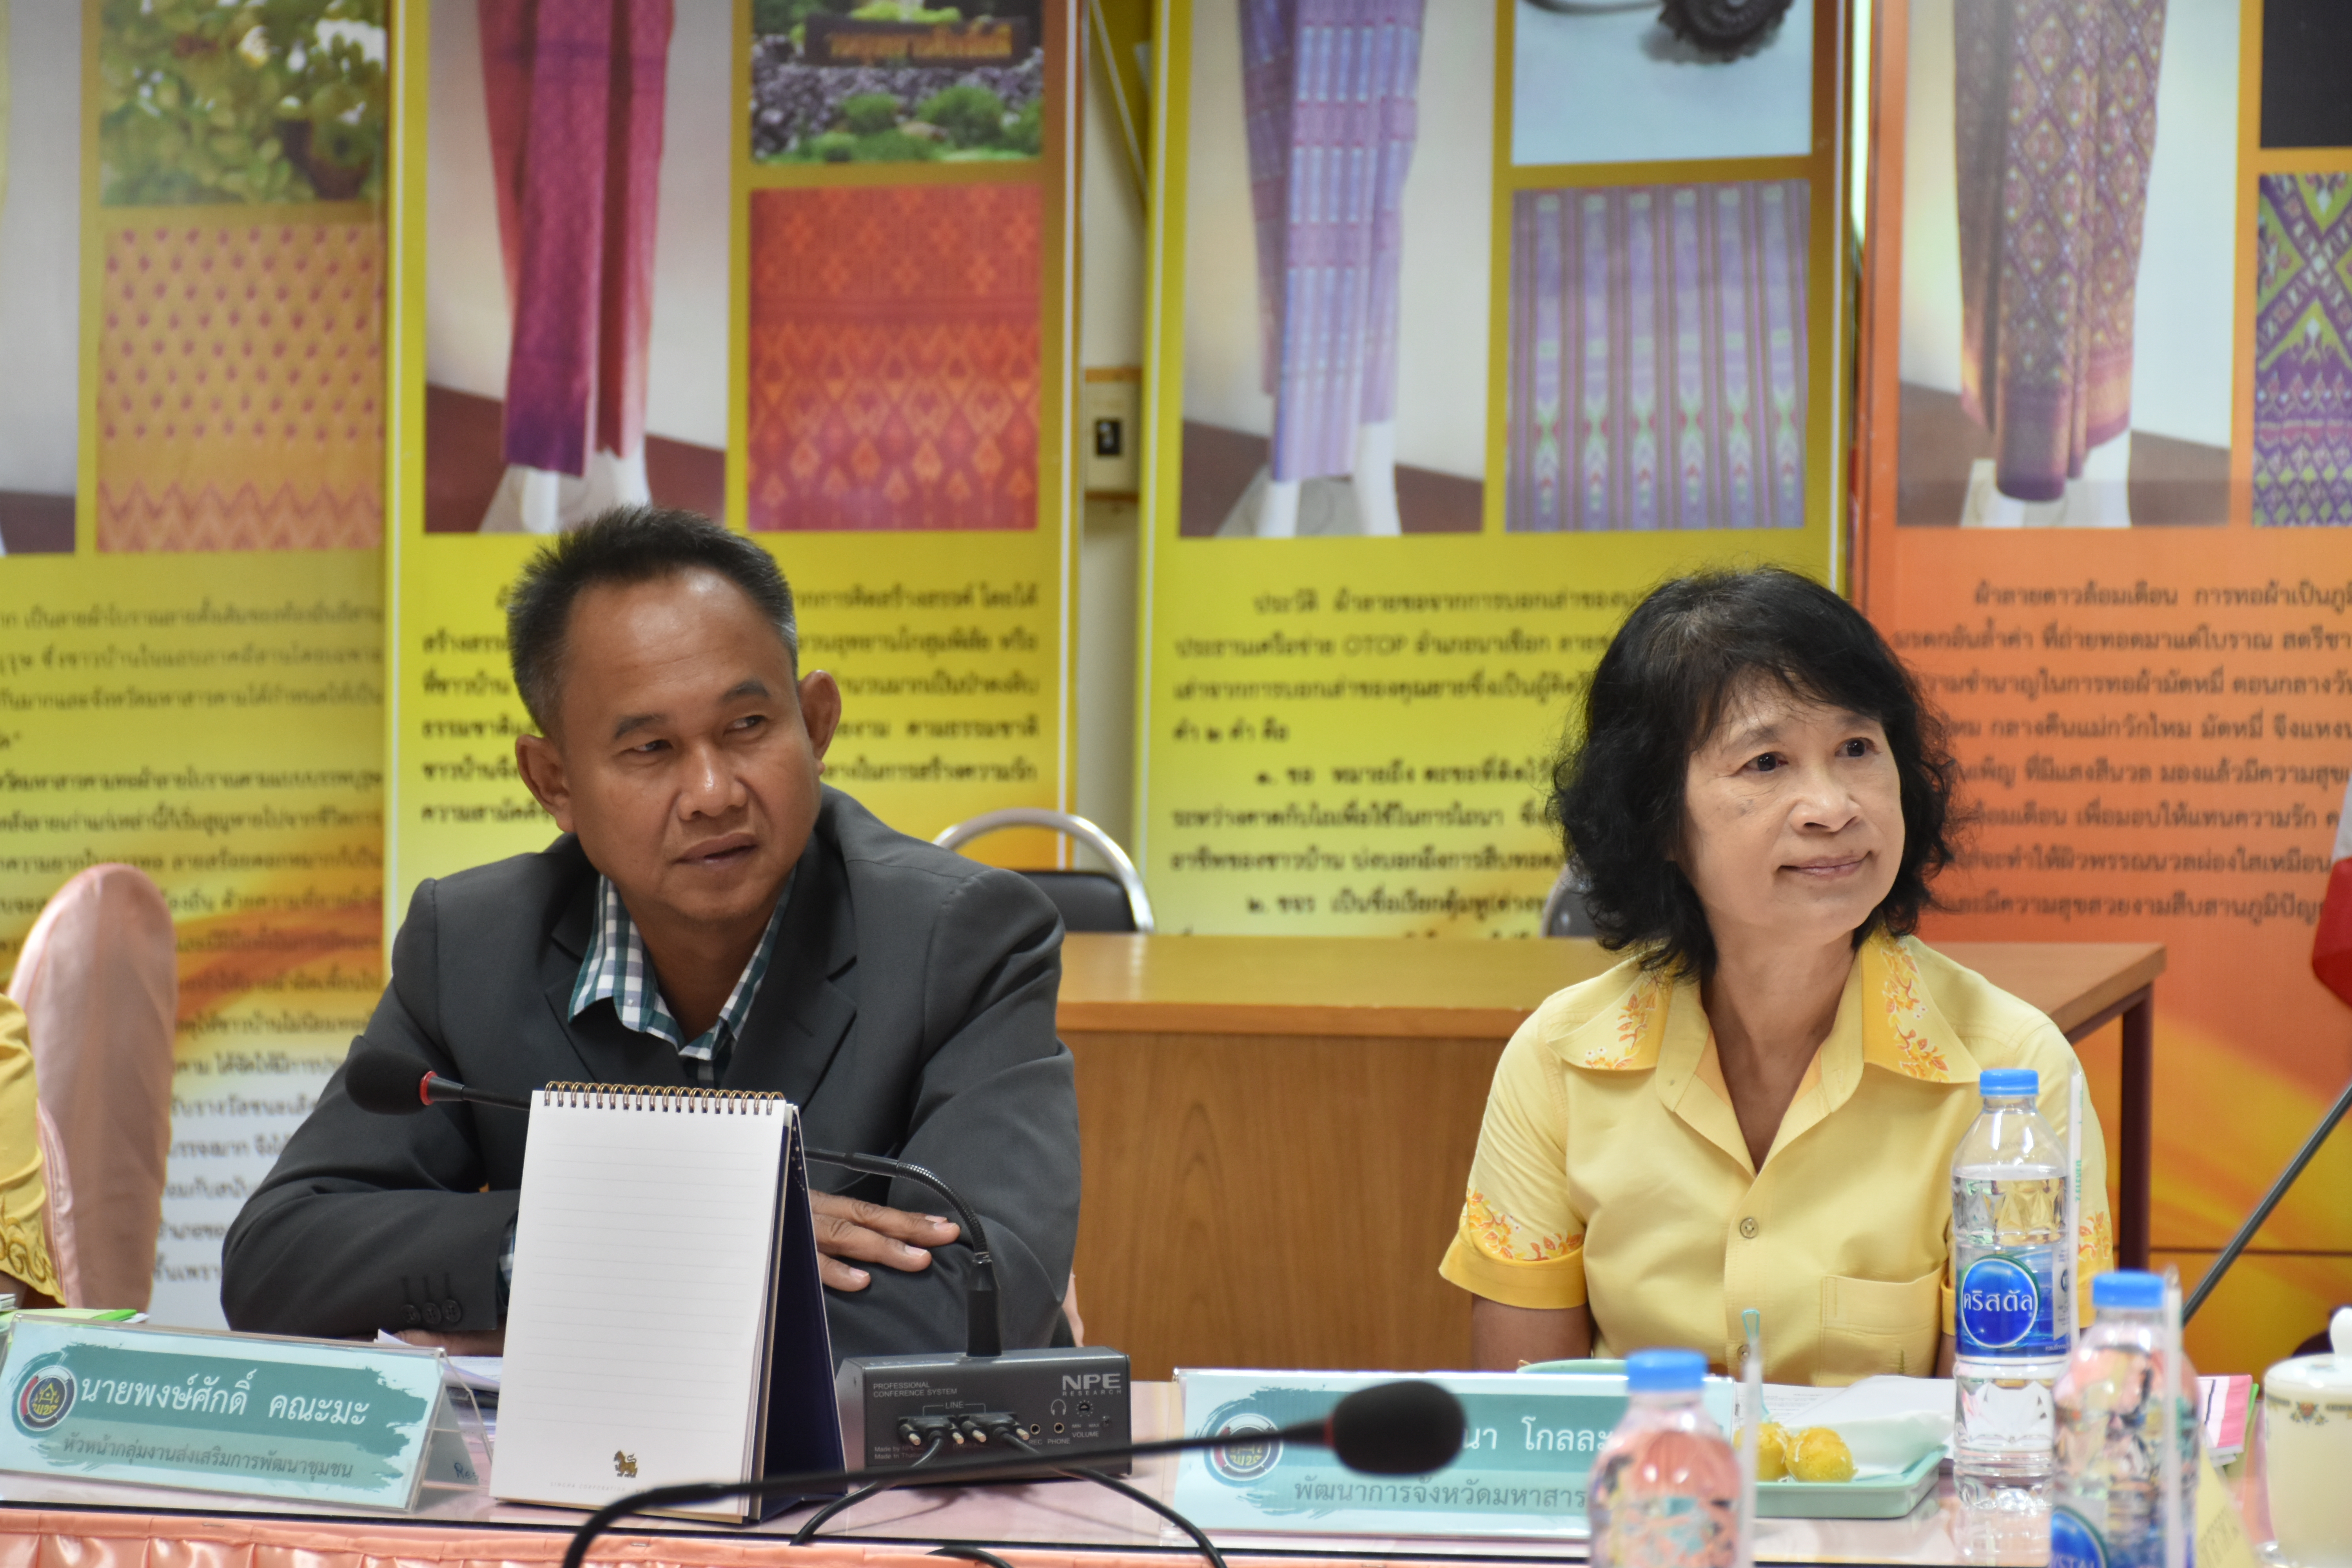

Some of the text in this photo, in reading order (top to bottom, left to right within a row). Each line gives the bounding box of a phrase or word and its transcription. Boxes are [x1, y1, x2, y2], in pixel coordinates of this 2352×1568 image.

[1341, 634, 1407, 656] OTOP
[1963, 1290, 2033, 1312] คริสตัล
[873, 1381, 930, 1390] PROFESSIONAL
[1062, 1373, 1121, 1390] NPE
[81, 1368, 370, 1425] นายพงษ์ศักดิ์ คณะมะ
[873, 1390, 924, 1398] CONFERENCE
[945, 1401, 964, 1409] LINE
[63, 1431, 353, 1483] หัวหน้ากลุ่มงานส่งเสริมการพัฒนาชุมชน
